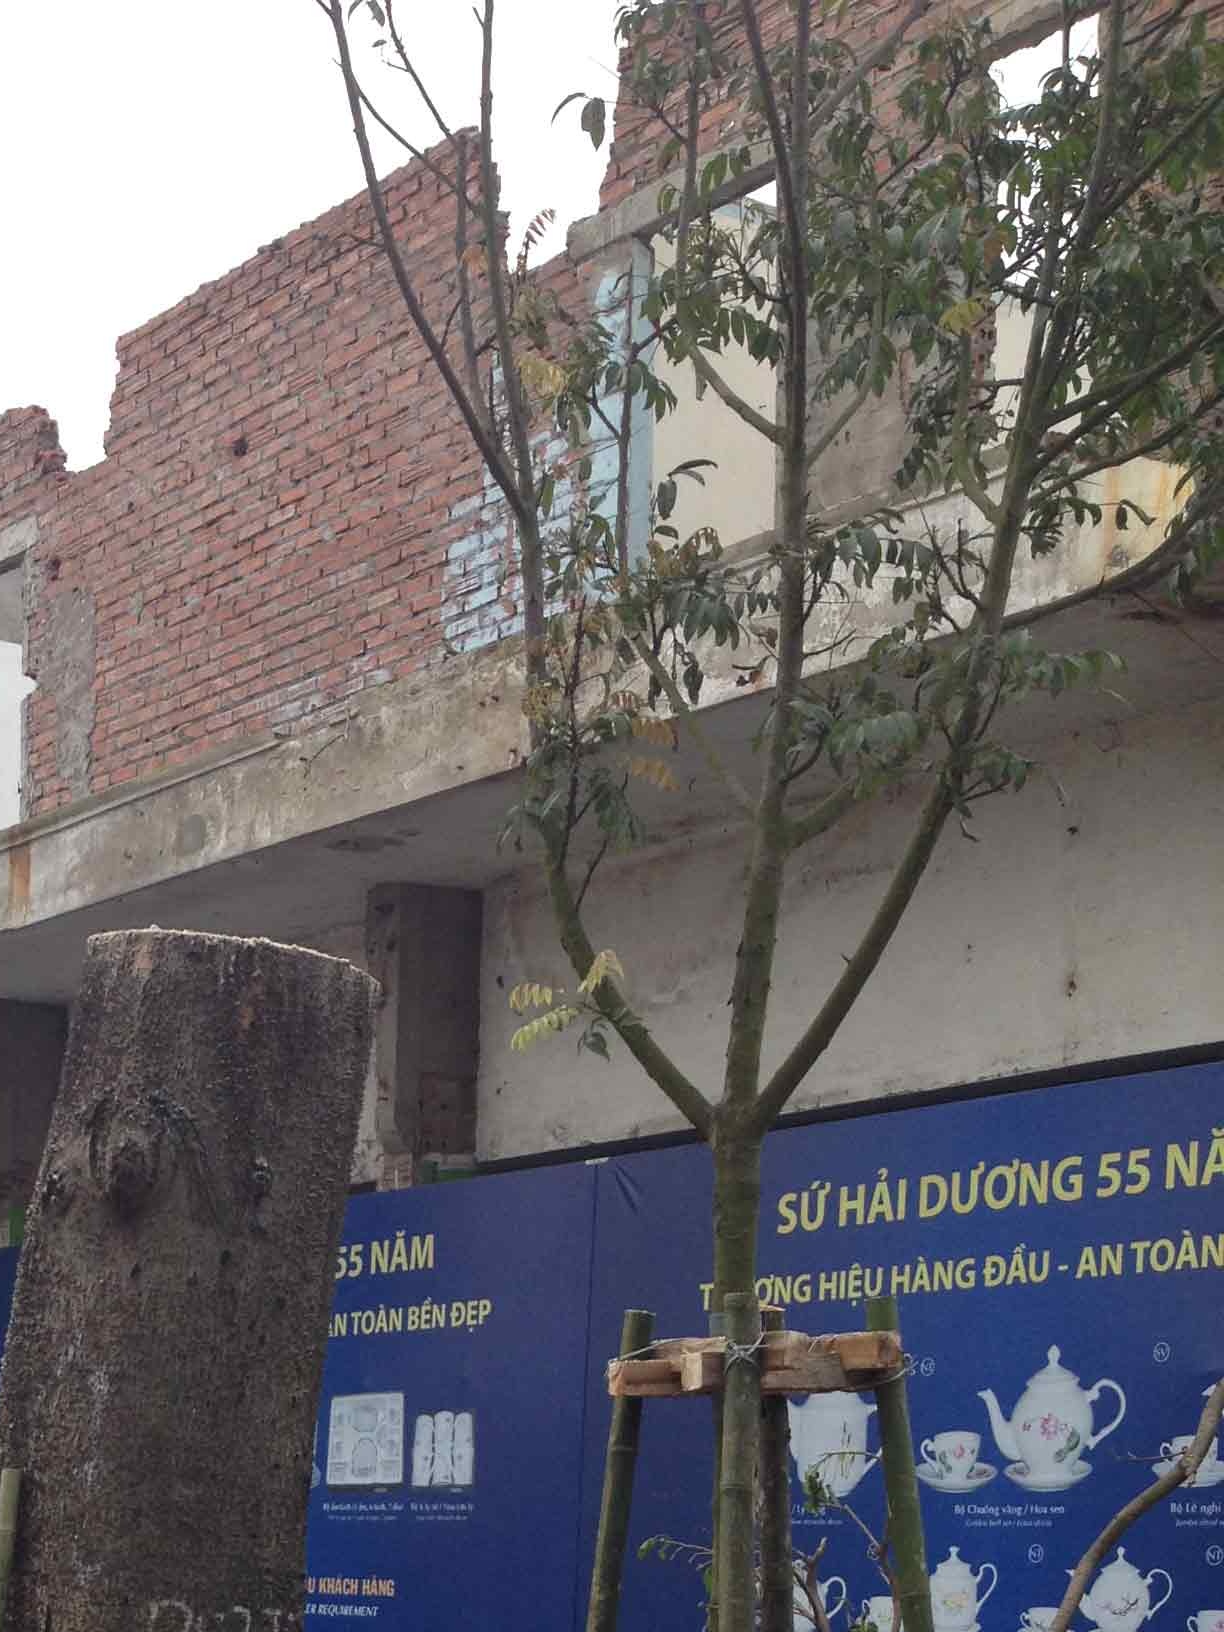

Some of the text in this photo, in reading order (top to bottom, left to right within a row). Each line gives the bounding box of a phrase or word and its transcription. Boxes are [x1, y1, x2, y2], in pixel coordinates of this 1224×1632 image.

[776, 1127, 1224, 1235] SỨ HẢI DƯƠNG 55 NĂ
[370, 1230, 435, 1276] NĂM
[699, 1273, 811, 1311] TƠNG
[819, 1262, 884, 1307] HIỆU
[890, 1255, 976, 1294] HÀNG
[983, 1242, 1050, 1287] ĐẦU
[1075, 1243, 1124, 1279] AN
[1130, 1229, 1224, 1274] TOÀN
[351, 1303, 403, 1336] TOÀN
[407, 1297, 446, 1331] BỀN
[449, 1299, 492, 1333] ĐẸP
